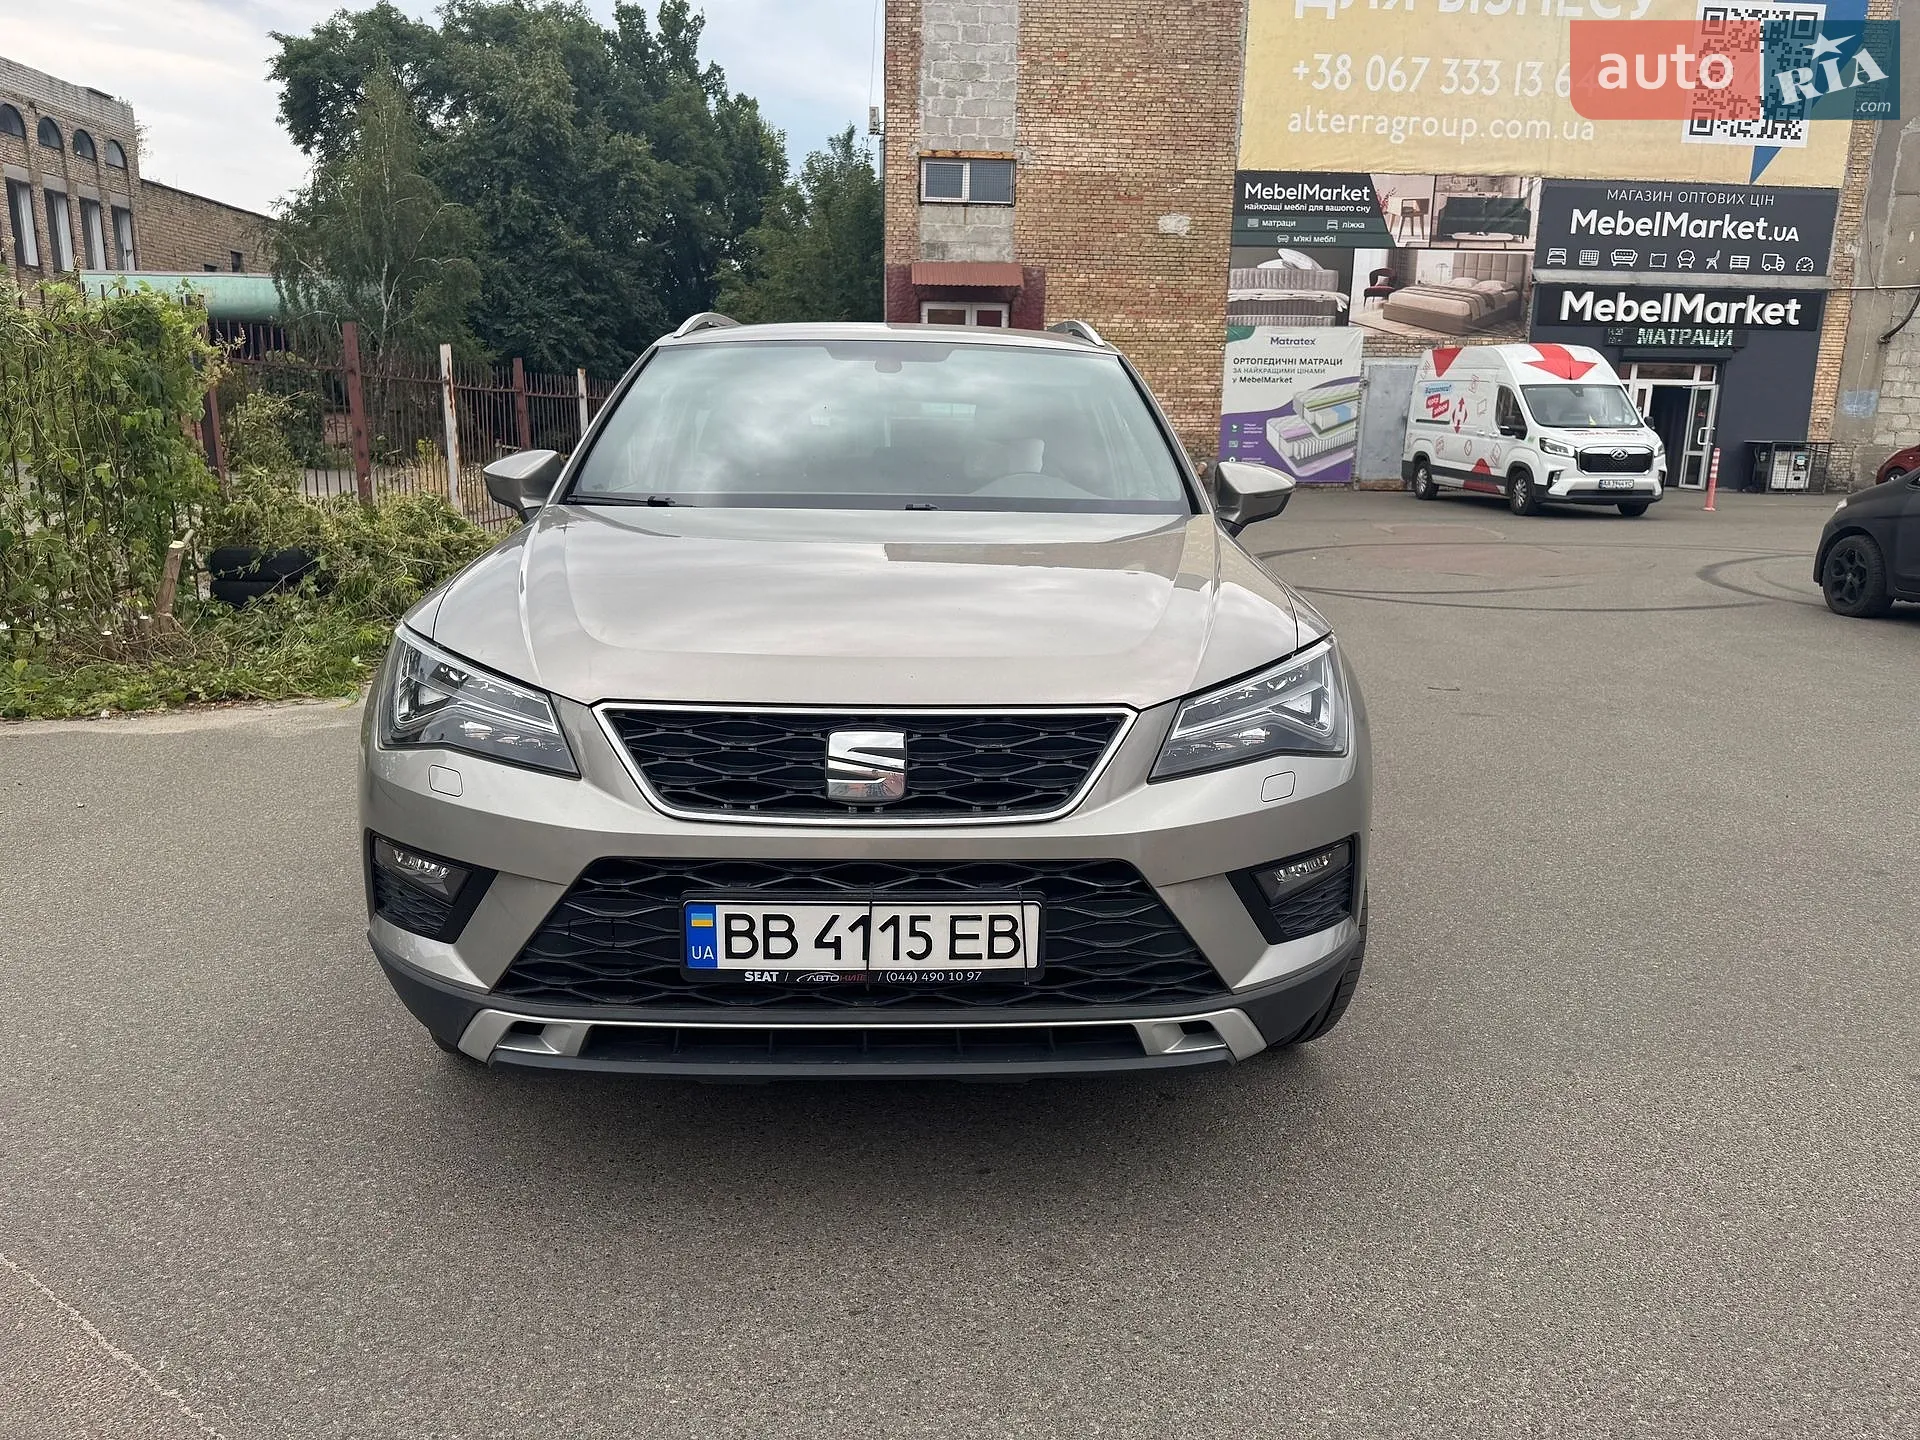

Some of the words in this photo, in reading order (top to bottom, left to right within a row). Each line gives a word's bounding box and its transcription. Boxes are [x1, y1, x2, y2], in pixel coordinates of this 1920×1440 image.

[1292, 53, 1352, 91] +38
[1365, 54, 1431, 92] 067
[1440, 58, 1502, 96] 333
[1513, 61, 1545, 97] 13
[1287, 105, 1595, 144] alterragroup.com.ua
[1244, 182, 1370, 201] MebelMarket
[1607, 189, 1673, 203] МАГАЗИН
[1677, 191, 1745, 205] ОПТОВИХ
[1750, 194, 1775, 207] ЦІН
[1244, 202, 1282, 212] найкращі
[1284, 203, 1307, 211] меблі
[1308, 204, 1324, 212] для
[1262, 219, 1296, 228] матраци
[1570, 208, 1800, 243] MebelMarket.UA
[1559, 290, 1801, 326] MebelMarket
[1270, 336, 1316, 346] Matratex
[1637, 327, 1733, 348] МАТРАЦИ
[1232, 357, 1297, 366] ОРТОПЕДИЧНІ
[1299, 358, 1343, 366] МАТРАЦИ
[1239, 376, 1293, 384] MebelMarket
[724, 913, 799, 961] BB
[813, 913, 934, 962] 4115
[948, 914, 1022, 962] EB
[691, 945, 715, 961] UA
[744, 971, 779, 982] SEAT
[886, 971, 918, 983] (044)
[921, 971, 945, 982] 490
[948, 971, 964, 982] 10
[966, 971, 982, 982] 97
